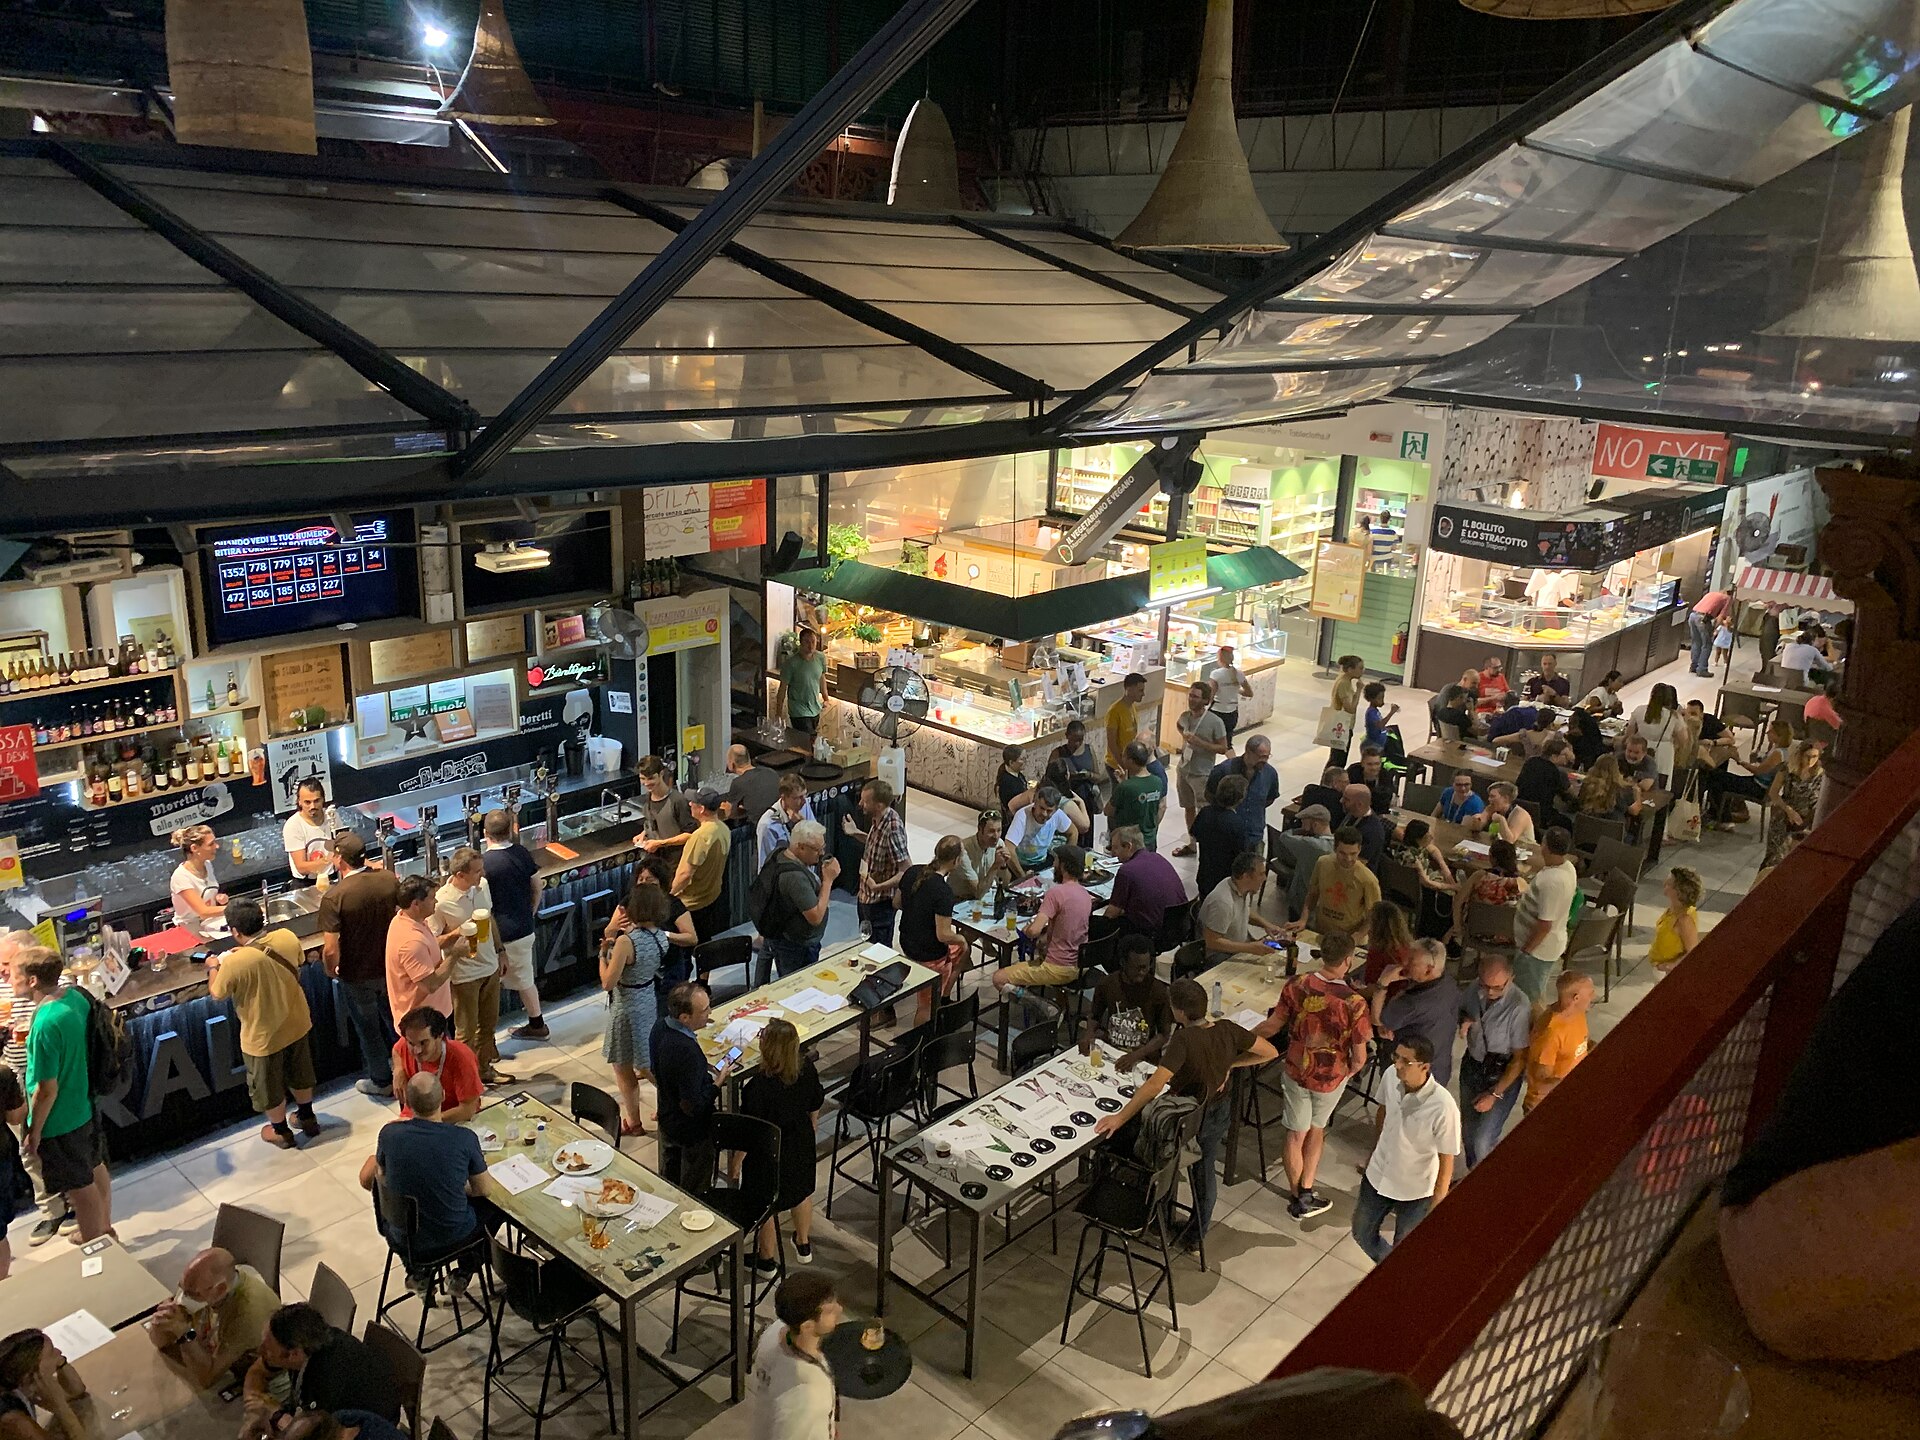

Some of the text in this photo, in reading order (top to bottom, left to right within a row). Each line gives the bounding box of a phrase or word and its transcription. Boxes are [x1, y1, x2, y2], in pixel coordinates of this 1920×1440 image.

[1598, 435, 1644, 470] NO
[1071, 502, 1108, 539] VEGETARIANO
[1107, 497, 1113, 505] E
[1110, 475, 1135, 500] VEGANO
[1463, 519, 1505, 534] IL BOLLITO
[278, 532, 294, 541] TUO
[1461, 528, 1528, 548] E LO STRACOTTO
[214, 547, 241, 557] RITIRA
[368, 550, 380, 560] 34
[297, 555, 314, 567] 325
[322, 553, 335, 564] 25
[346, 553, 358, 563] 32
[249, 562, 267, 573] 778
[273, 559, 291, 570] 779
[221, 567, 245, 578] 1352
[299, 582, 317, 593] 633
[322, 579, 339, 590] 227
[251, 588, 270, 600] 506
[276, 585, 293, 596] 185
[226, 592, 245, 603] 472
[281, 738, 316, 751] MORETTI
[7, 750, 30, 764] DESK
[150, 791, 199, 817] Moretti
[156, 812, 198, 832] alla spina
[1111, 1015, 1137, 1029] TEAM
